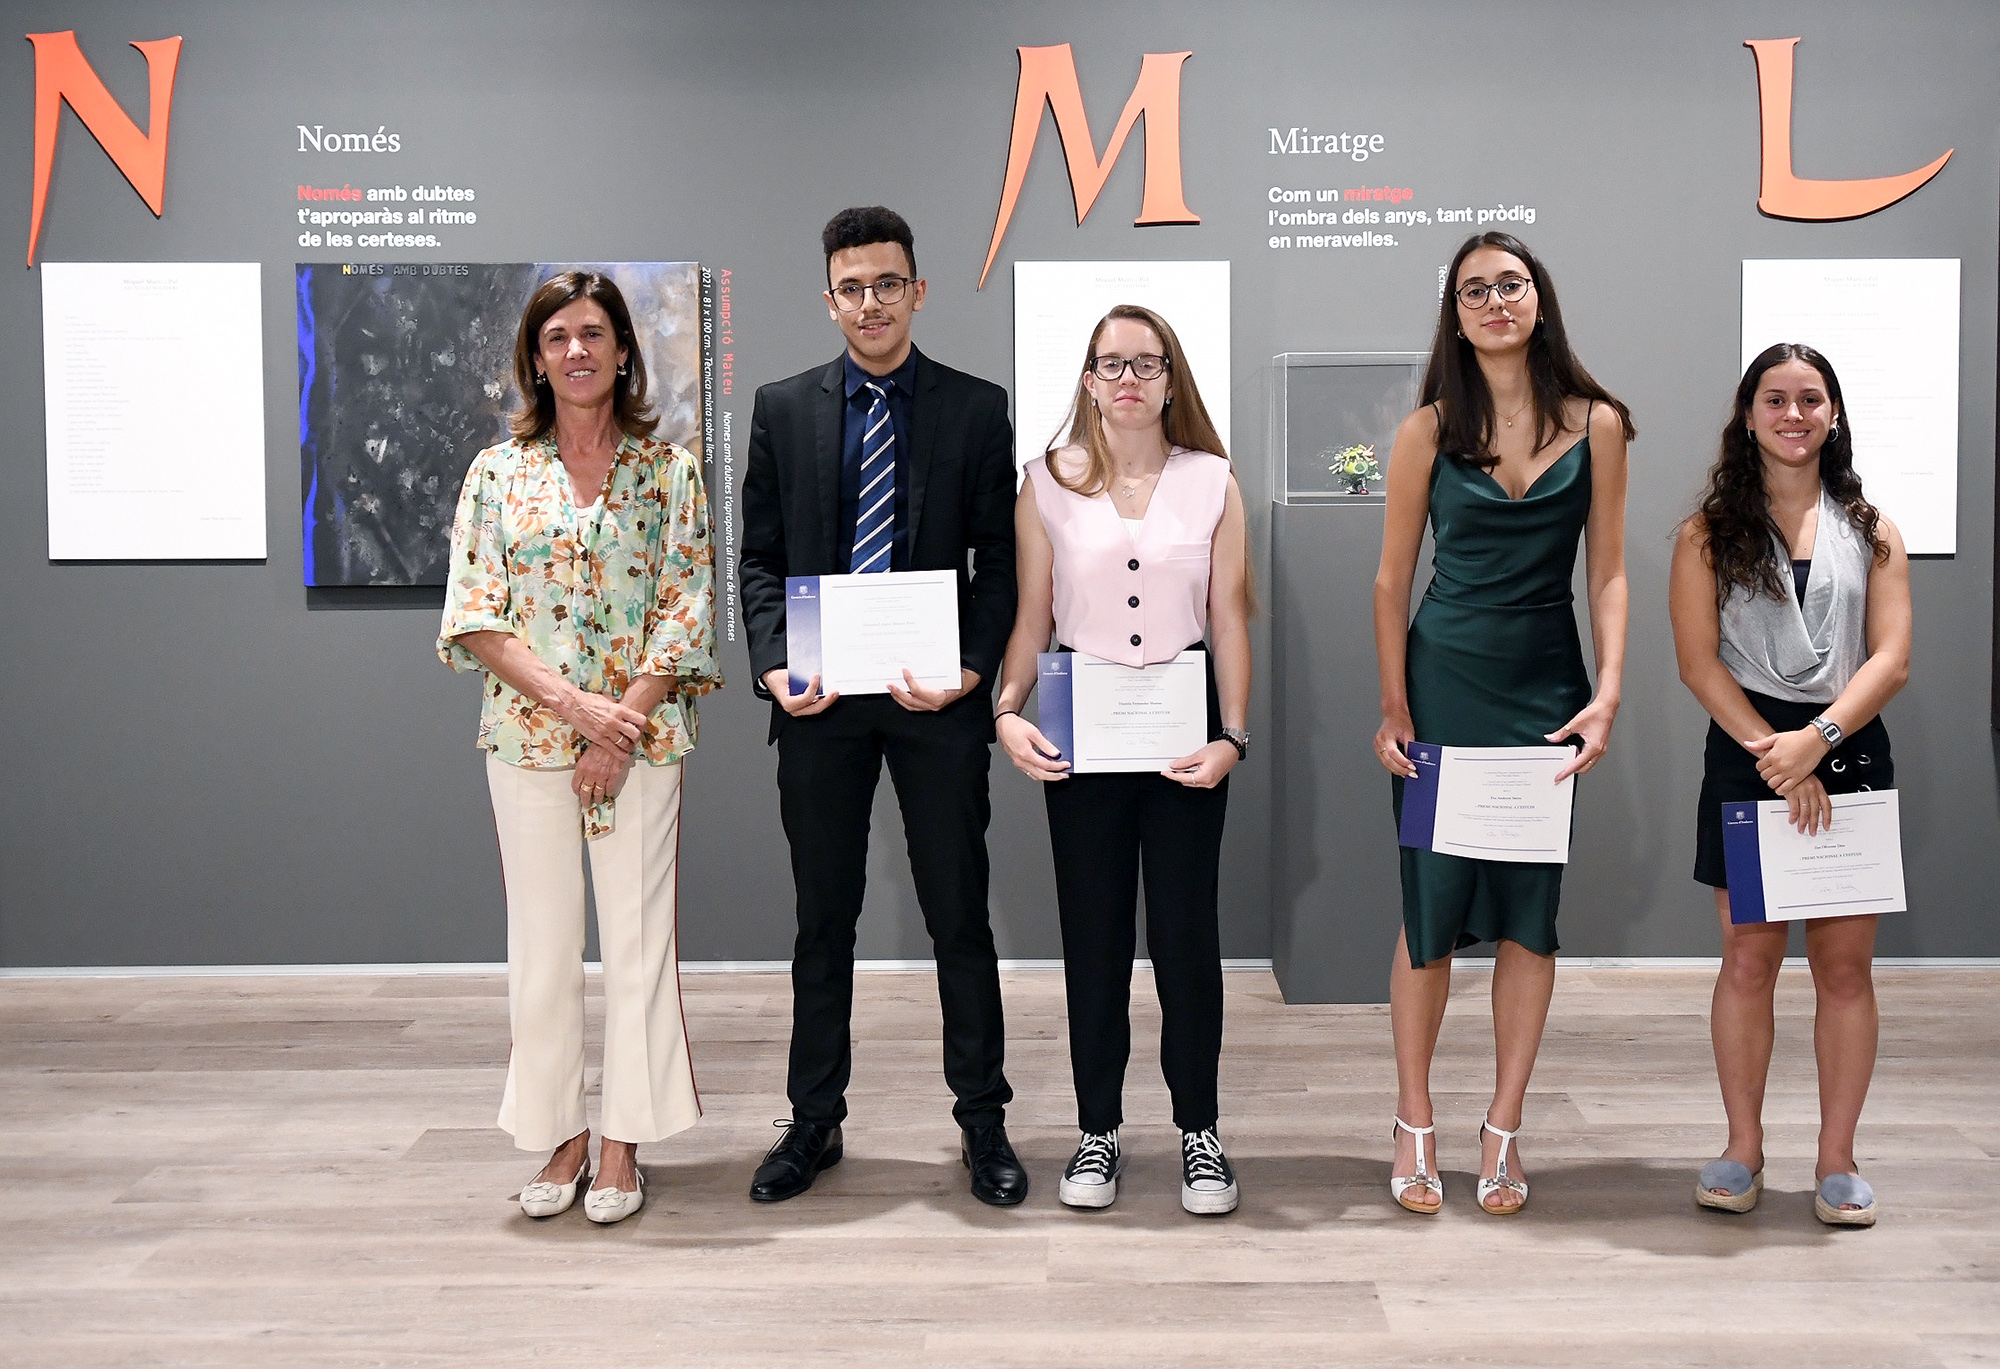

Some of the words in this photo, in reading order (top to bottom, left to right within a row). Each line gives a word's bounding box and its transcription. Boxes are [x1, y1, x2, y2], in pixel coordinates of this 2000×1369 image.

[297, 125, 401, 152] Només
[1743, 37, 1954, 221] L
[25, 29, 183, 267] N
[1268, 127, 1385, 162] Miratge
[977, 43, 1200, 291] M
[298, 184, 362, 201] Només
[367, 185, 407, 201] amb
[412, 185, 475, 201] dubtes
[1268, 186, 1311, 203] Com
[1316, 189, 1339, 202] un
[1344, 186, 1413, 204] miratge
[407, 209, 424, 224] al
[429, 208, 477, 224] ritme
[1342, 208, 1380, 224] dels
[1385, 209, 1432, 227] anys,
[1436, 206, 1472, 223] tant
[1477, 204, 1536, 225] pròdig
[298, 231, 322, 247] de
[326, 231, 353, 247] les
[357, 231, 441, 247] certeses.
[1268, 234, 1291, 249] en
[1296, 231, 1398, 248] meravelles.
[342, 263, 384, 276] NOMÉS
[393, 265, 417, 275] AMB
[423, 265, 469, 276] DUBTES
[702, 266, 711, 288] 2021
[703, 297, 712, 307] 81
[720, 268, 733, 345] Assumpció
[704, 318, 712, 334] 100
[704, 357, 714, 390] Tècnica
[722, 353, 734, 395] Mateu
[705, 391, 714, 416] mixta
[706, 418, 714, 442] sobre
[704, 444, 714, 464] llenç
[724, 443, 733, 463] amb
[724, 465, 733, 494] dubtes
[726, 547, 735, 556] al
[726, 557, 735, 580] ritme
[727, 582, 736, 592] de
[727, 594, 736, 606] les
[727, 607, 736, 641] certeses
